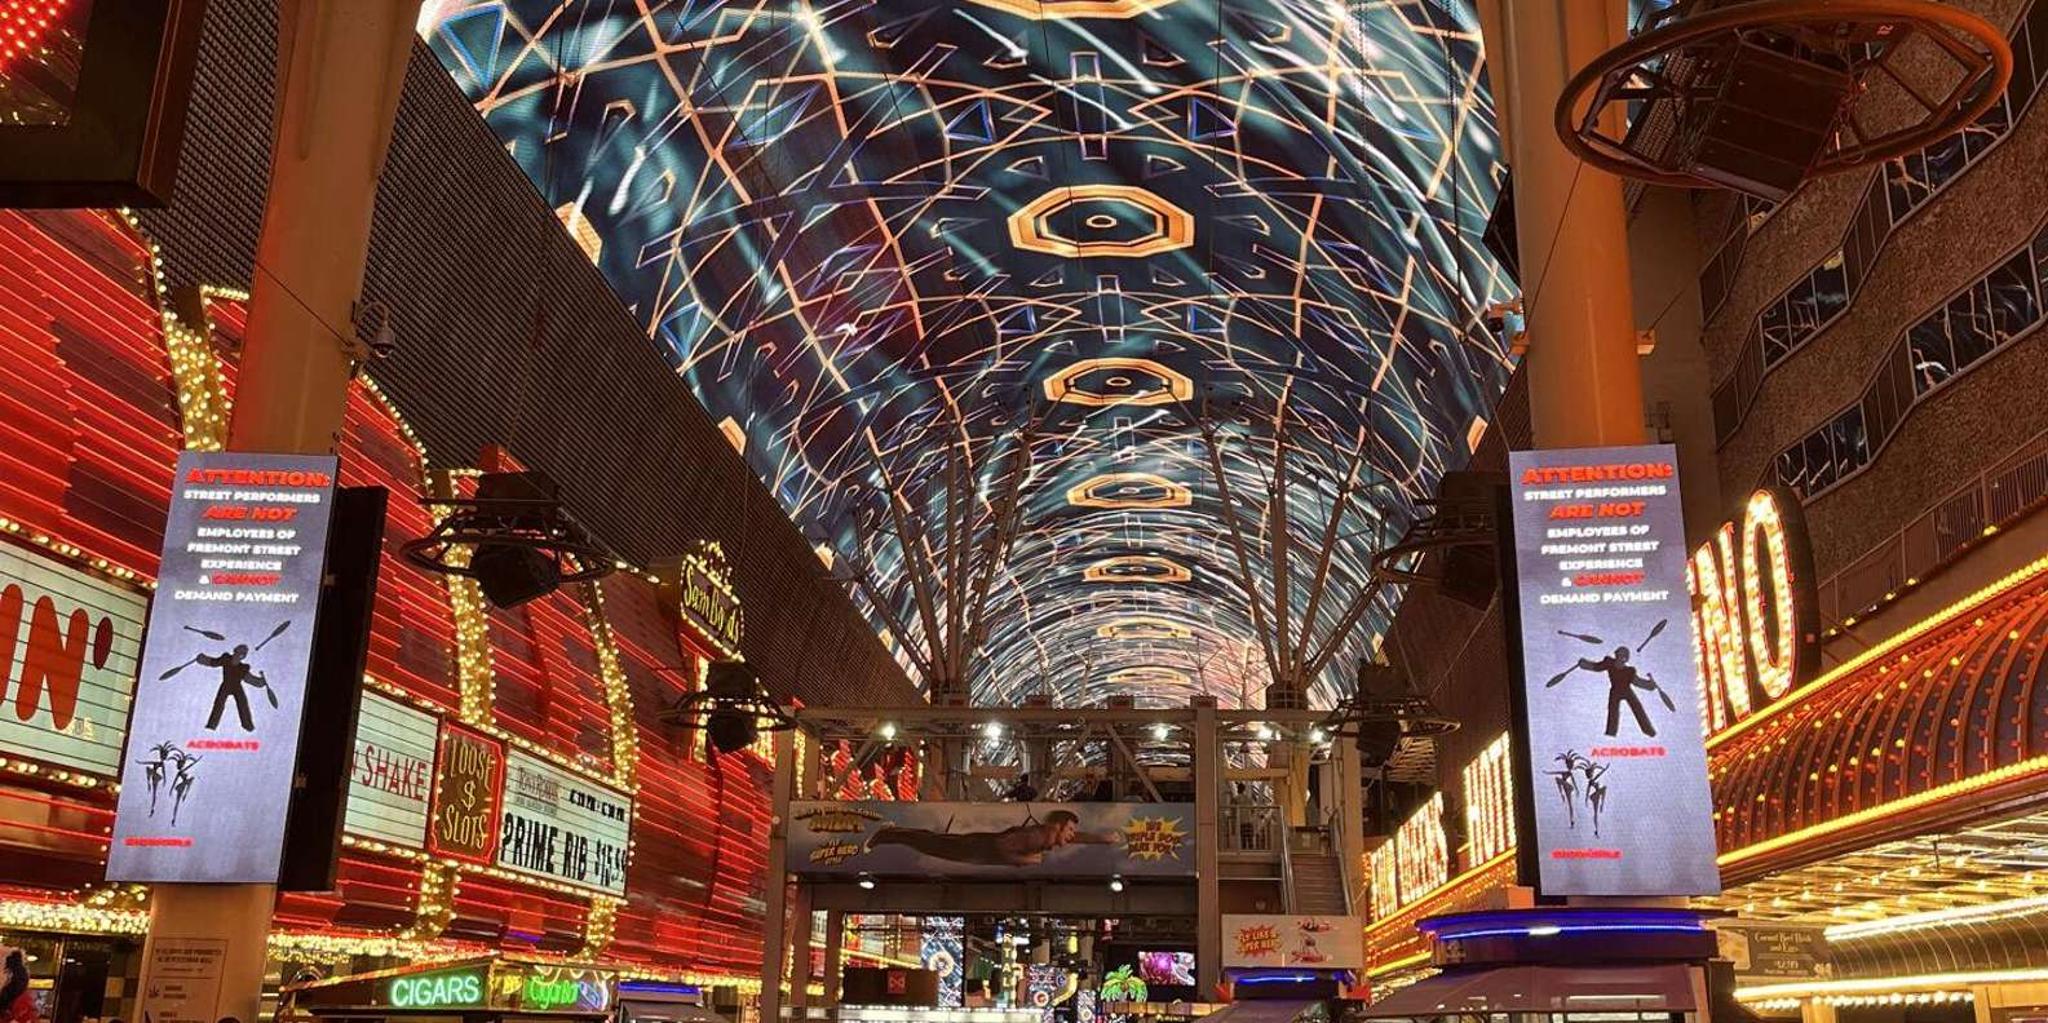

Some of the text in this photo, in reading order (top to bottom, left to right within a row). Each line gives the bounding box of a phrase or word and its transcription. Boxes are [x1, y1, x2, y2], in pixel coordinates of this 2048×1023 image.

[186, 468, 331, 488] ATTENTION:
[1522, 463, 1674, 486] ATTENTION:
[184, 490, 320, 503] STREET PERFORMERS
[1524, 485, 1667, 501] STREET PERFORMERS
[203, 505, 297, 521] ARE NOT
[1549, 501, 1646, 519] ARE NOT
[197, 527, 296, 539] EMPLOYEES OF
[1547, 525, 1650, 539] EMPLOYEES OF
[187, 543, 301, 556] FREMONT STREET
[1541, 541, 1660, 555] FREMONT STREET
[201, 559, 282, 571] EXPERIENCE
[1559, 558, 1643, 571] EXPERIENCE
[1561, 577, 1572, 587] &
[175, 590, 299, 604] DEMAND PAYMENT
[1540, 590, 1669, 605] DEMAND PAYMENT
[186, 740, 259, 751] ACROBATS
[1591, 746, 1666, 757] ACROBATS
[362, 745, 427, 801] SHAKE
[450, 738, 495, 793] LOOSE
[461, 779, 476, 811] $
[444, 804, 487, 849] SLOTS
[502, 812, 558, 874] PRIME
[562, 831, 588, 881] RIB
[391, 975, 480, 1007] CIGARS
